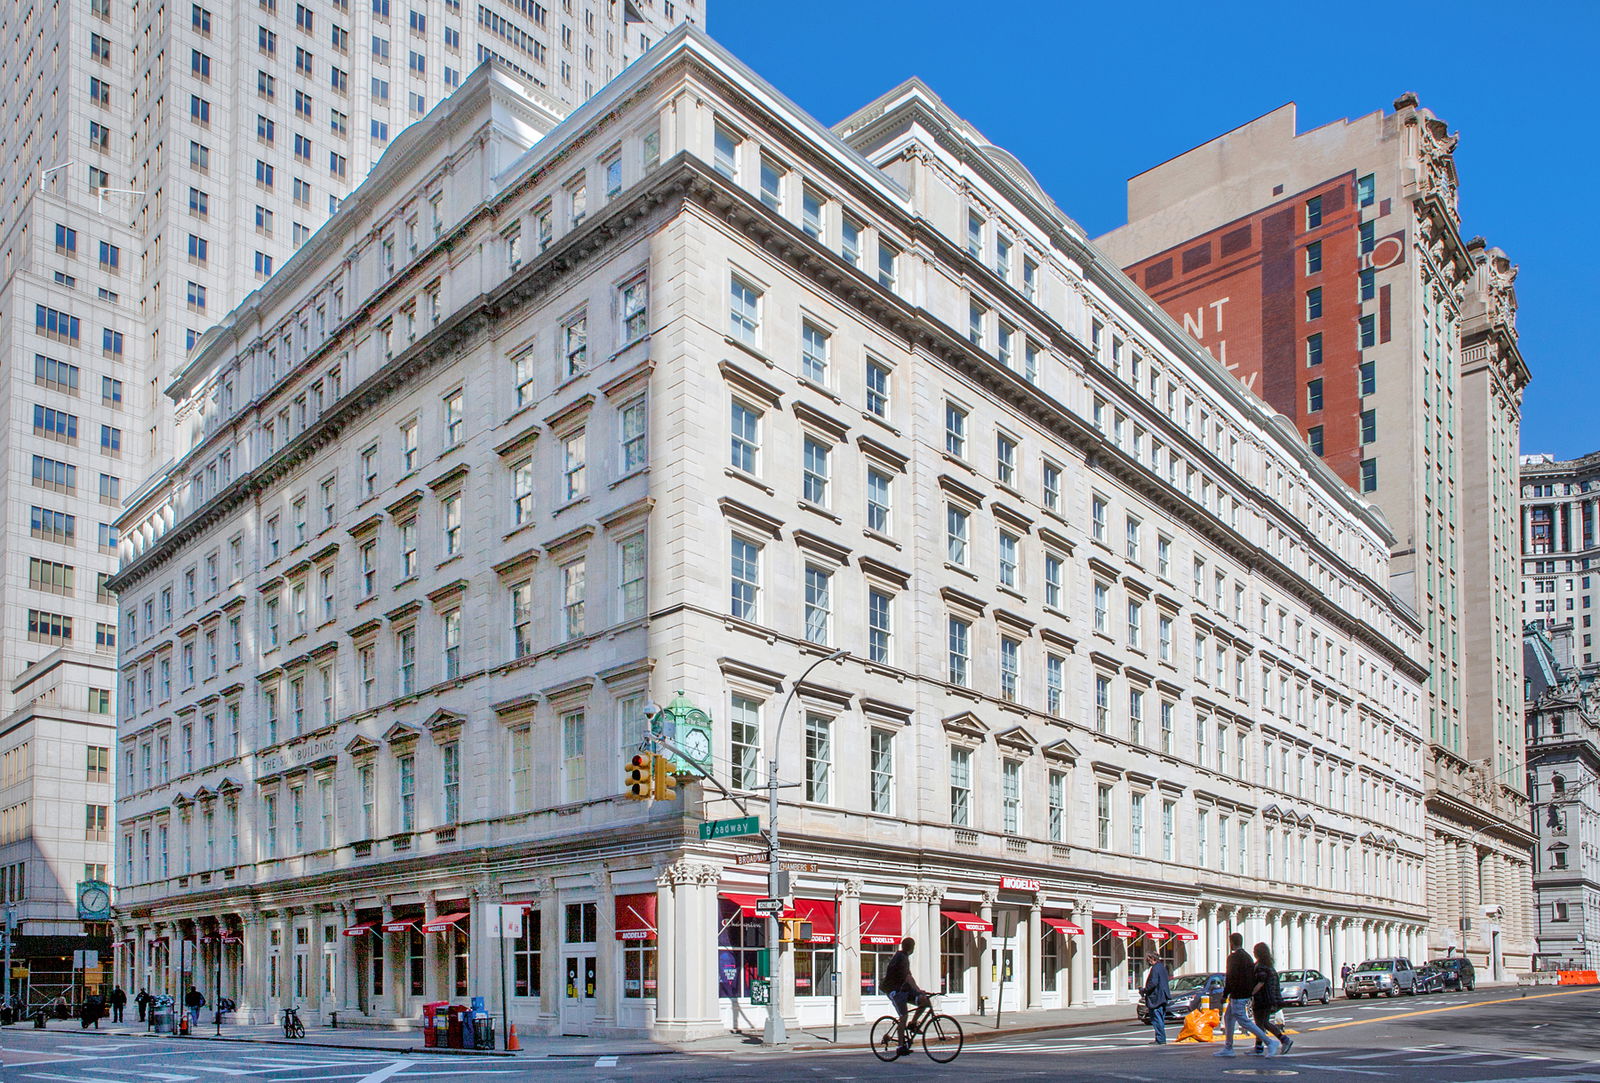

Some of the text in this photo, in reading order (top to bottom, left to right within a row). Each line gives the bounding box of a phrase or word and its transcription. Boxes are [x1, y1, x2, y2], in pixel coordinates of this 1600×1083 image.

[738, 853, 768, 865] BROADWAY
[780, 862, 818, 873] CHAMBERS ST
[1003, 878, 1040, 891] MODELL'S
[622, 931, 648, 939] MODELL'S
[870, 936, 895, 944] MODELL'S
